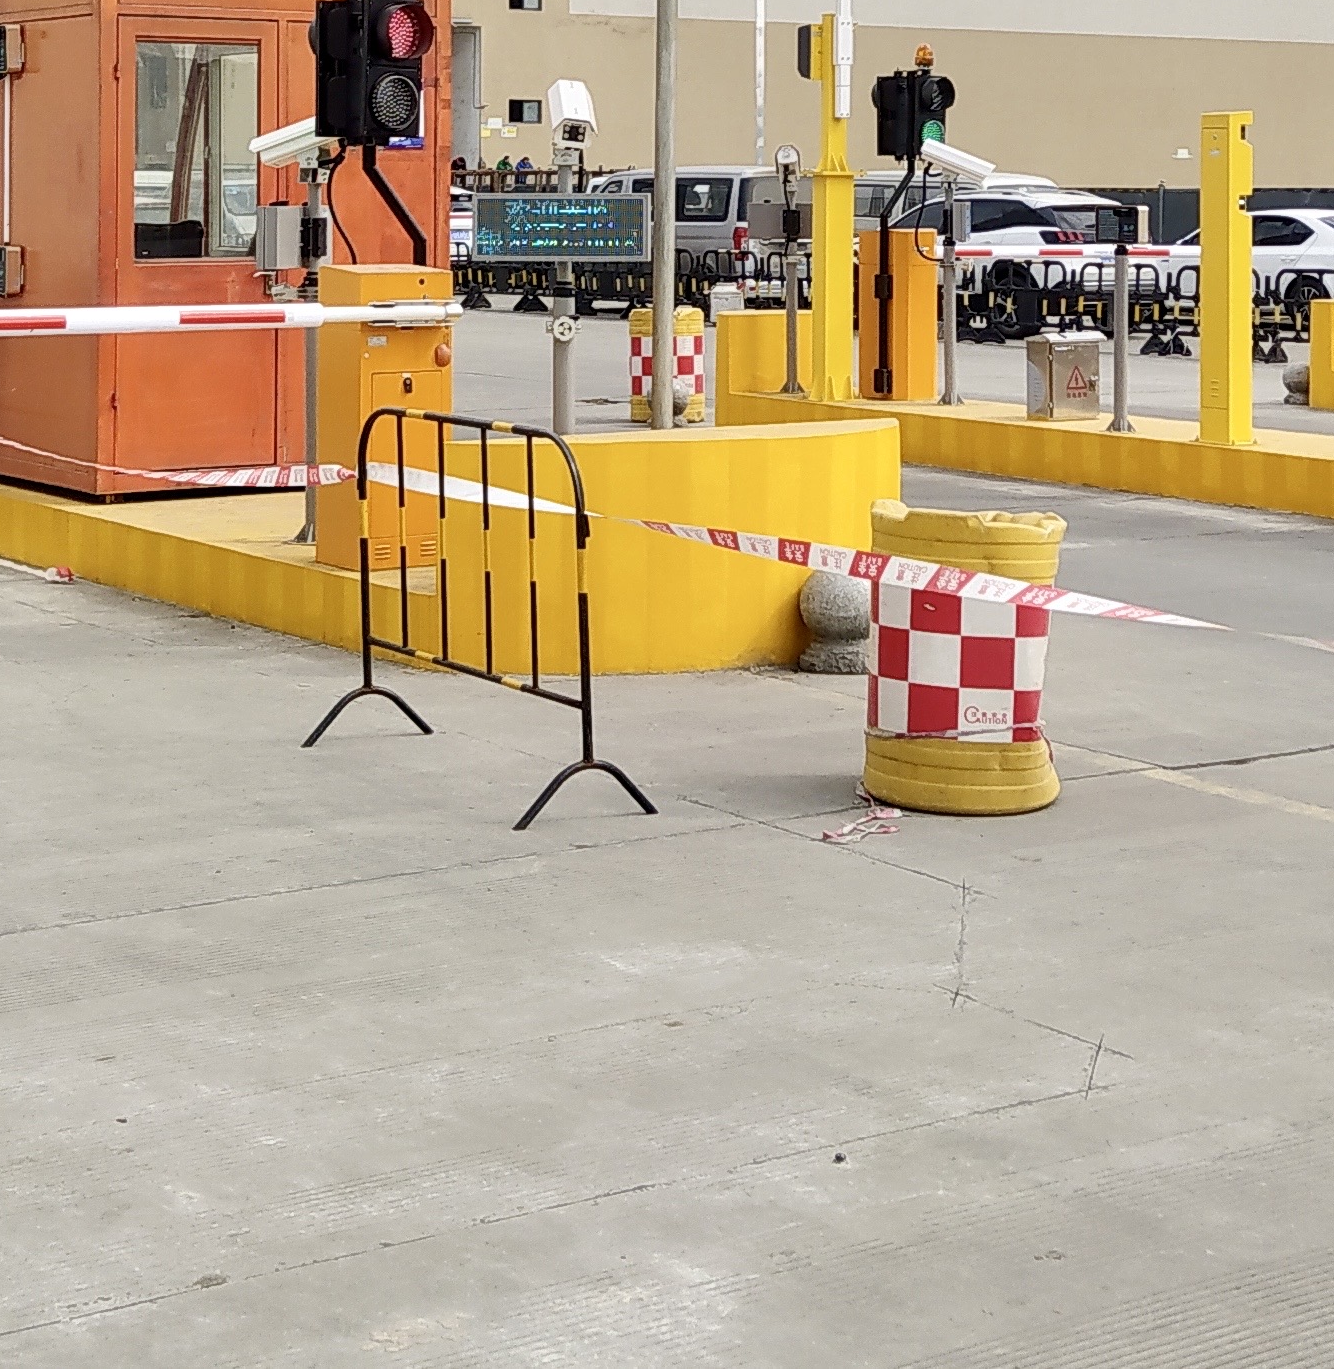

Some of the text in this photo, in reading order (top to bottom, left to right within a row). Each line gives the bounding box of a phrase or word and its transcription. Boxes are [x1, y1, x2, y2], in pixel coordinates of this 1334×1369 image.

[819, 547, 848, 560] CAUTION
[898, 561, 928, 574] CAUTION
[964, 705, 1008, 724] CAUTION
